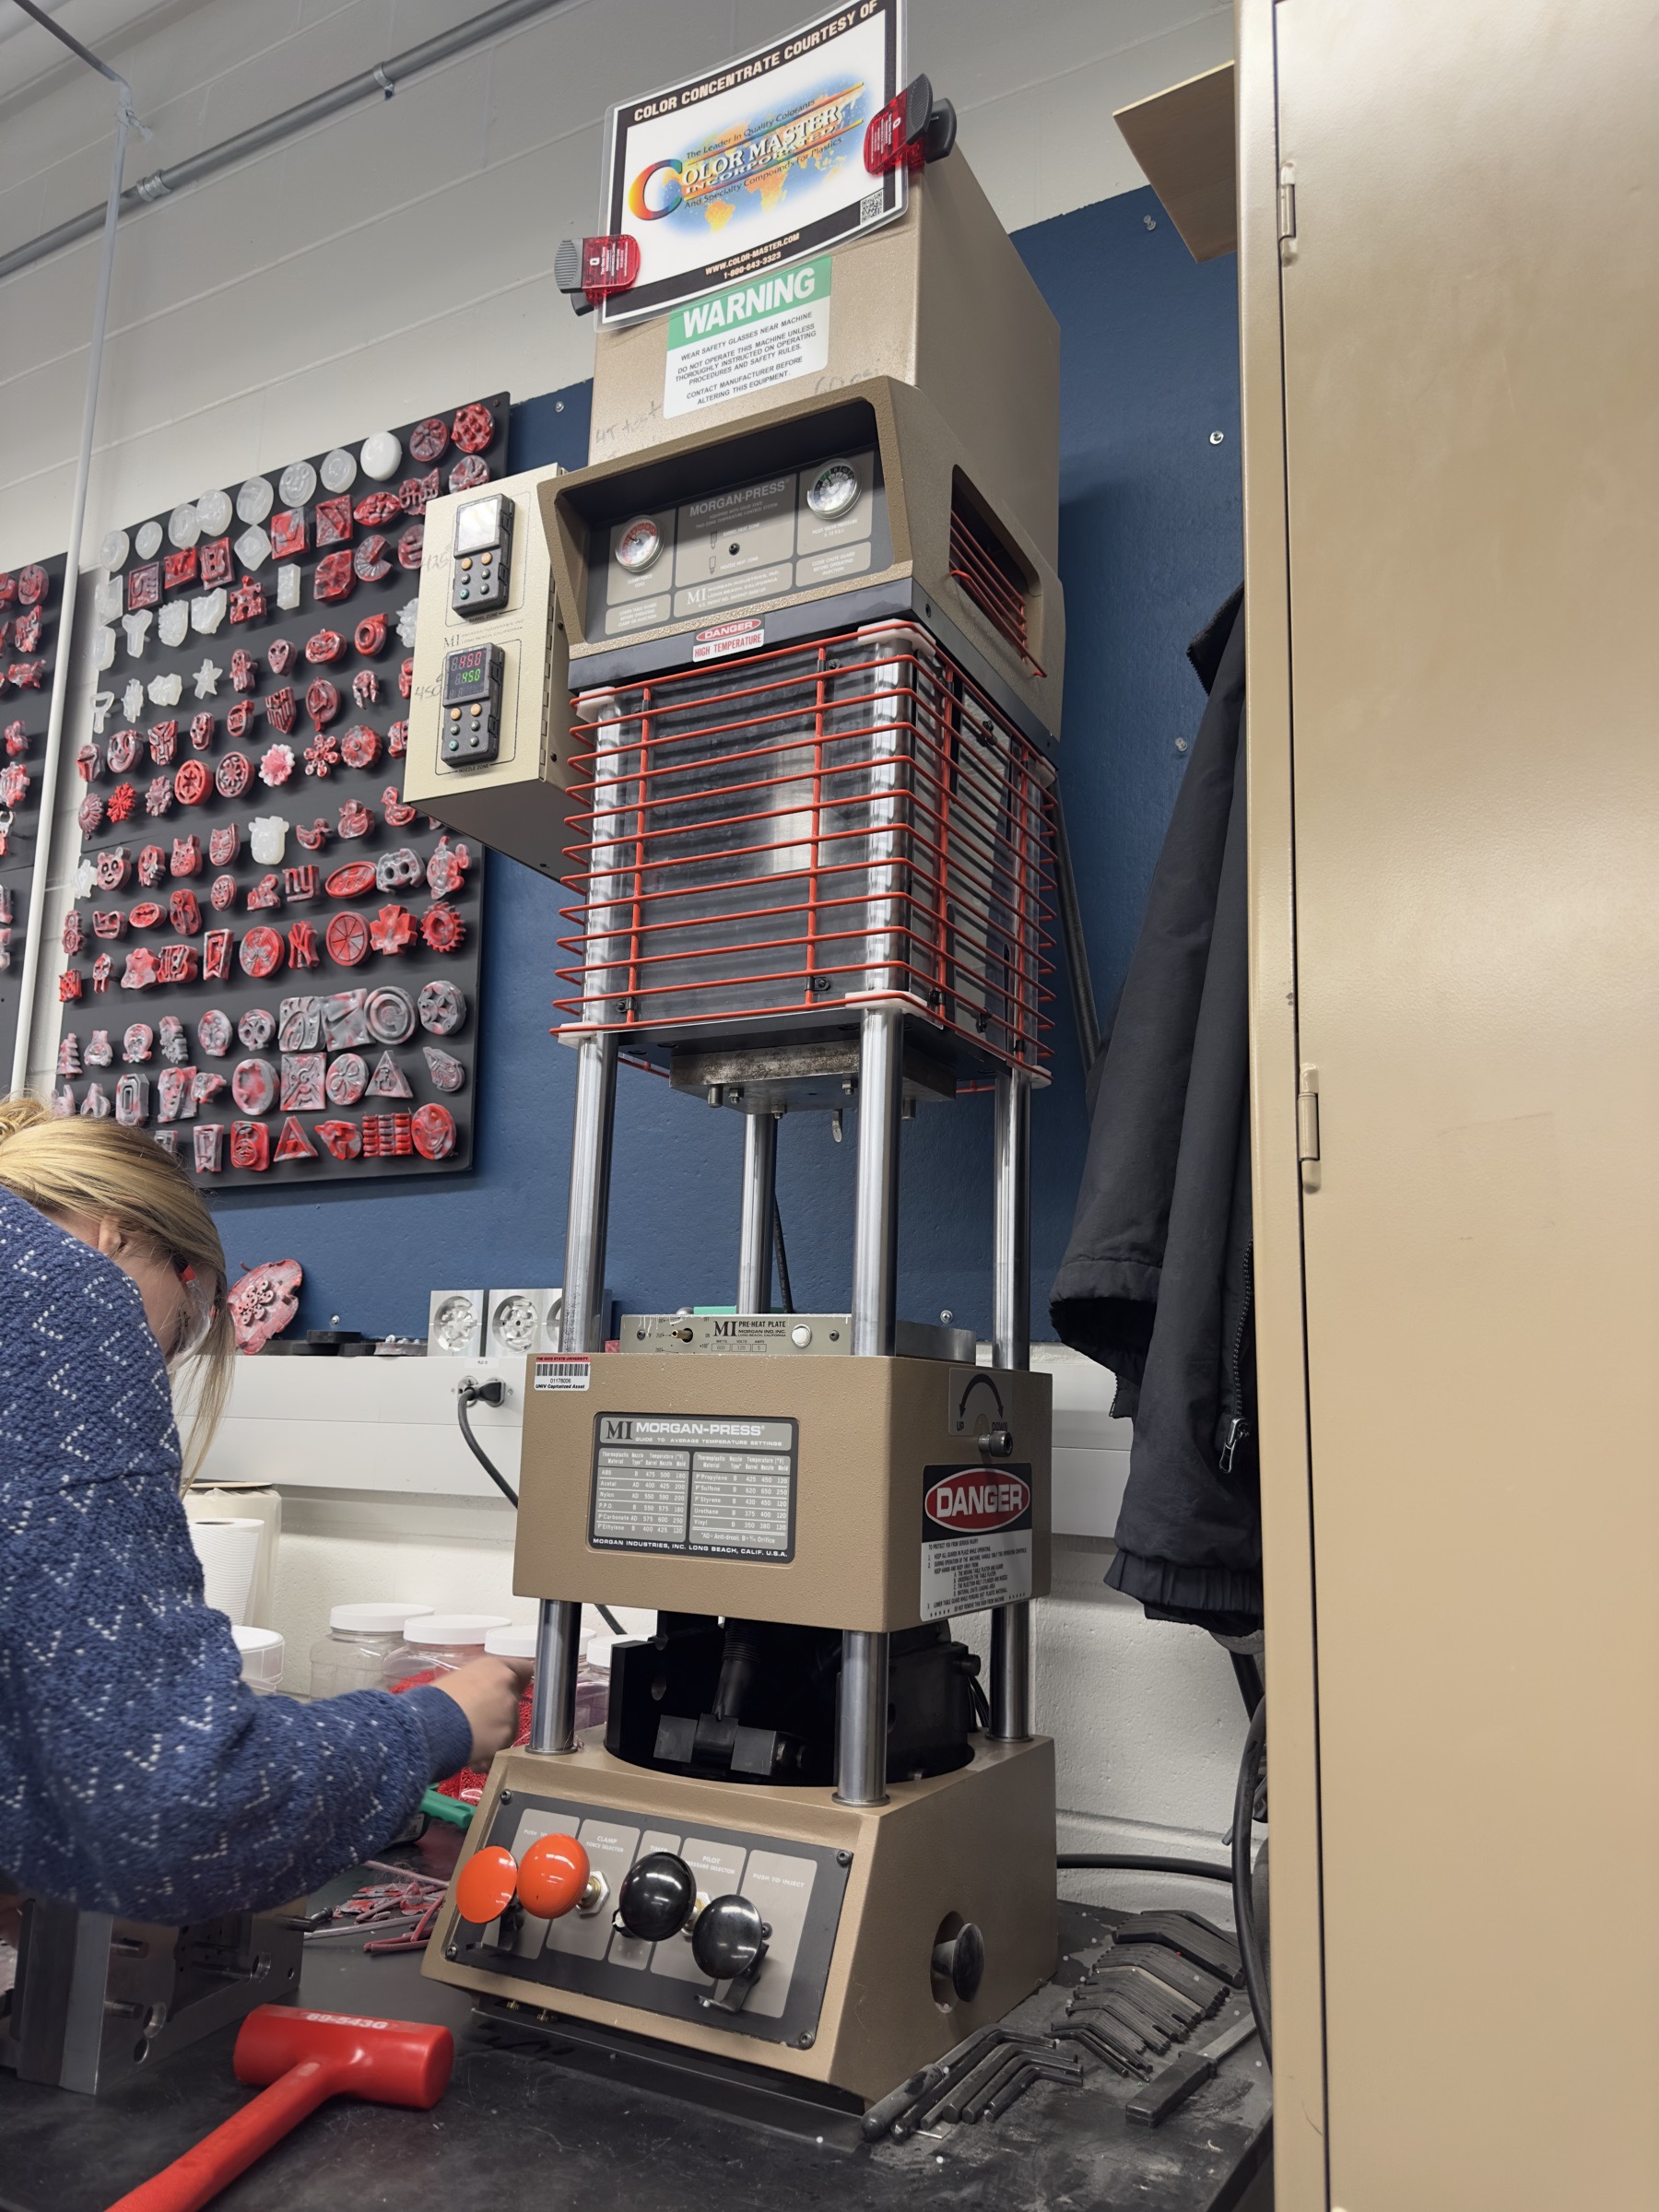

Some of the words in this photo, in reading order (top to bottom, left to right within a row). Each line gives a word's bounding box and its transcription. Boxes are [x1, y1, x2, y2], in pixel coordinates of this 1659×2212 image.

[634, 96, 677, 122] COLOR
[681, 52, 781, 105] CONCENTRATE
[784, 10, 856, 60] COURTESY
[860, 0, 878, 18] OF
[687, 149, 700, 159] The
[703, 138, 732, 153] Leader
[734, 134, 742, 142] In
[744, 119, 775, 137] Quality
[776, 100, 816, 123] Colorants
[749, 106, 840, 161] MASTER
[685, 196, 702, 209] And
[704, 182, 742, 204] Specialty
[744, 159, 794, 187] Compounds
[797, 152, 809, 164] For
[811, 136, 842, 156] Plastics
[705, 232, 800, 275] WWW.COLOR-MASTER.COM
[683, 267, 816, 338] WARNING
[677, 366, 688, 374] DO
[689, 360, 703, 371] NOT
[704, 351, 735, 366] OPERATE
[737, 344, 753, 354] THIS
[755, 334, 786, 348] MACHINE
[788, 324, 815, 337] UNLESS
[681, 350, 700, 361] WEAR
[701, 341, 726, 356] SAFETY
[728, 331, 759, 346] GLASSES
[760, 323, 779, 335] NEAR
[781, 312, 812, 327] MACHINE
[676, 362, 719, 382] THOROUGHLY
[721, 349, 763, 368] INSTRUCTED
[764, 344, 775, 353] ON
[776, 330, 817, 348] OPERATING
[688, 367, 732, 385] PROCEDURES
[735, 360, 748, 371] AND
[750, 352, 776, 366] SAFETY
[778, 344, 802, 357] RULES.
[687, 384, 717, 399] CONTACT
[719, 365, 774, 388] MANUFACTURER
[776, 356, 803, 370] BEFORE
[698, 390, 730, 406] ALTERING
[733, 382, 747, 393] THIS
[749, 371, 791, 388] EQUIPMENT.
[687, 587, 707, 605] MI
[704, 621, 753, 639] DANGER
[694, 646, 711, 658] HIGH
[713, 633, 762, 653] TEMPERATURE
[462, 668, 481, 683] 450
[713, 1321, 737, 1336] MI
[606, 1420, 633, 1440] MI
[957, 1421, 964, 1431] UP
[992, 1421, 1008, 1431] DOWN
[935, 1483, 1022, 1518] DANGER
[626, 1540, 670, 1549] INDUSTRIES,
[711, 1547, 739, 1555] BEACH,
[586, 1841, 602, 1849] FORCE
[602, 1843, 624, 1853] SELECTOR
[596, 1836, 618, 1844] CLAMP
[702, 1855, 721, 1865] PILOT
[710, 1865, 735, 1875] SELECTOR
[752, 1873, 770, 1881] PUSH
[782, 1878, 805, 1888] INJECT
